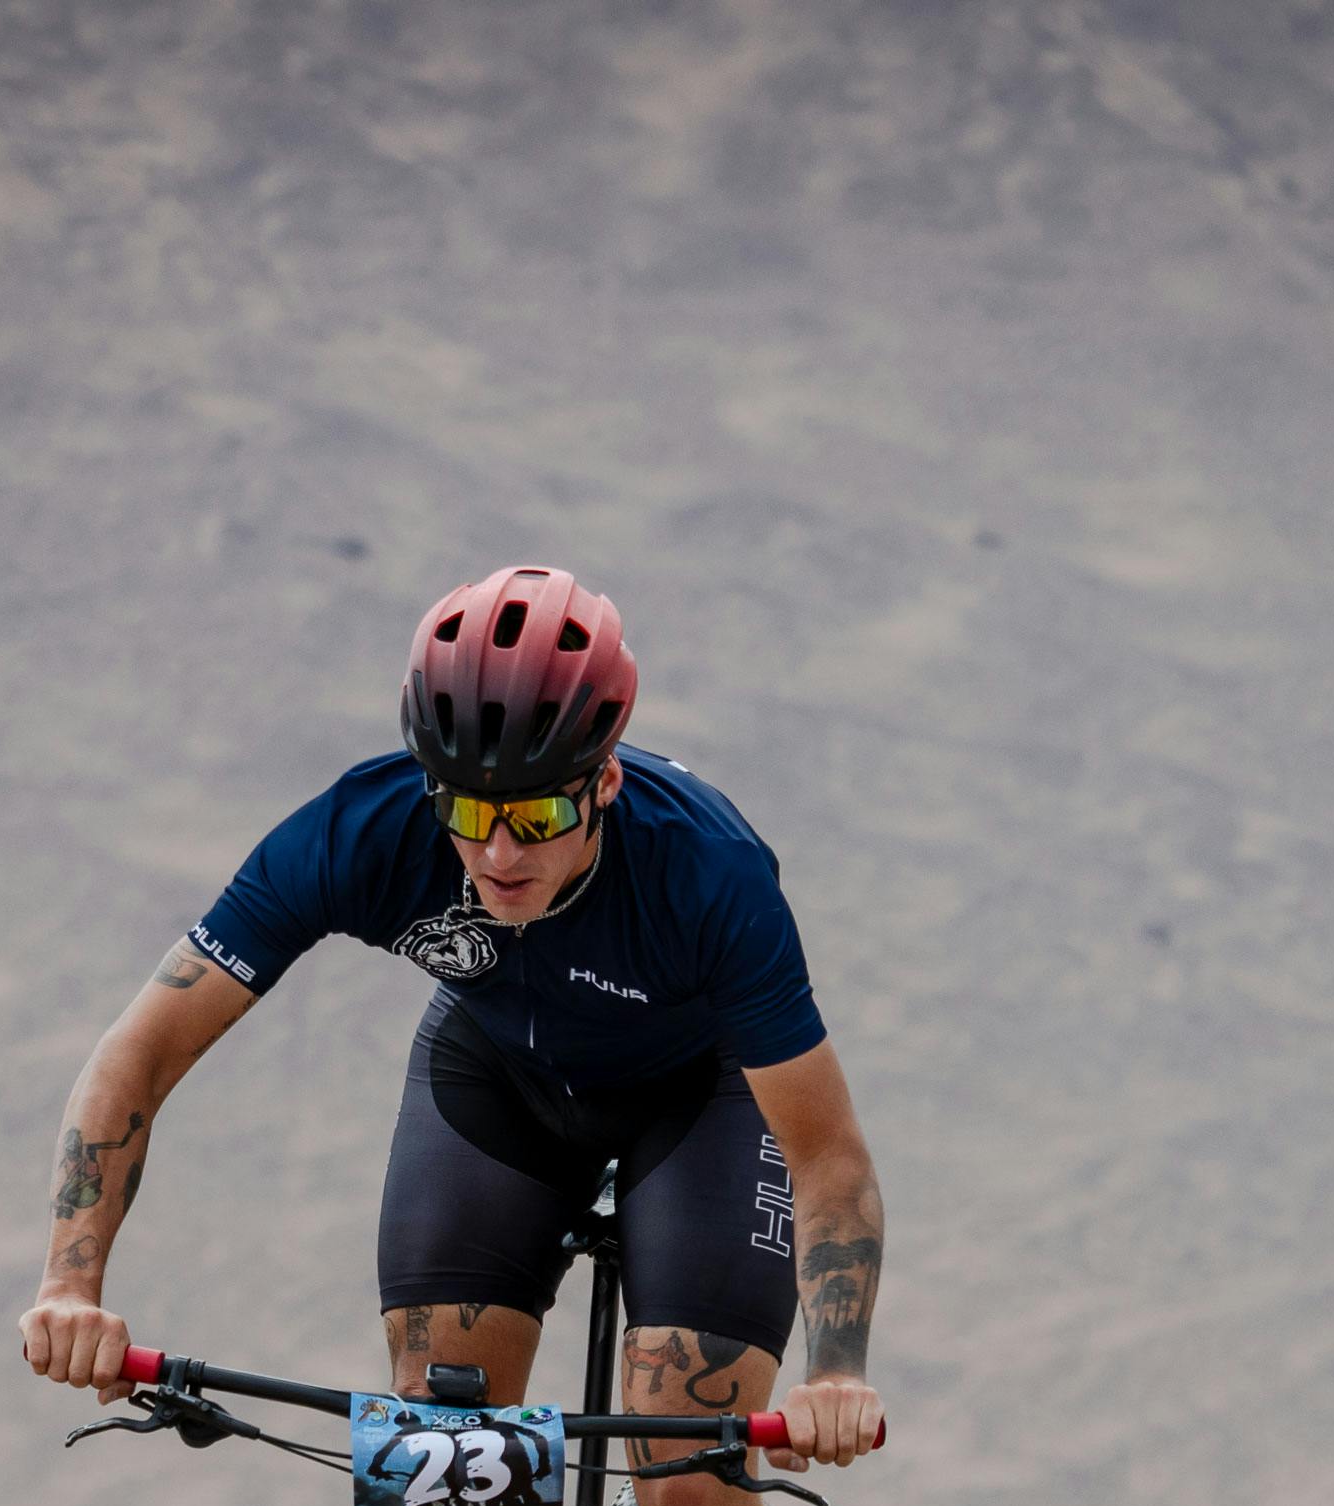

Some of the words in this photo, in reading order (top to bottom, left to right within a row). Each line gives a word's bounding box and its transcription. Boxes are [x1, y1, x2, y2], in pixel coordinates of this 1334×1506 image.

[190, 920, 257, 983] HUUB
[569, 967, 649, 1004] HUUB
[751, 1134, 795, 1259] HU
[432, 1414, 483, 1426] XCO
